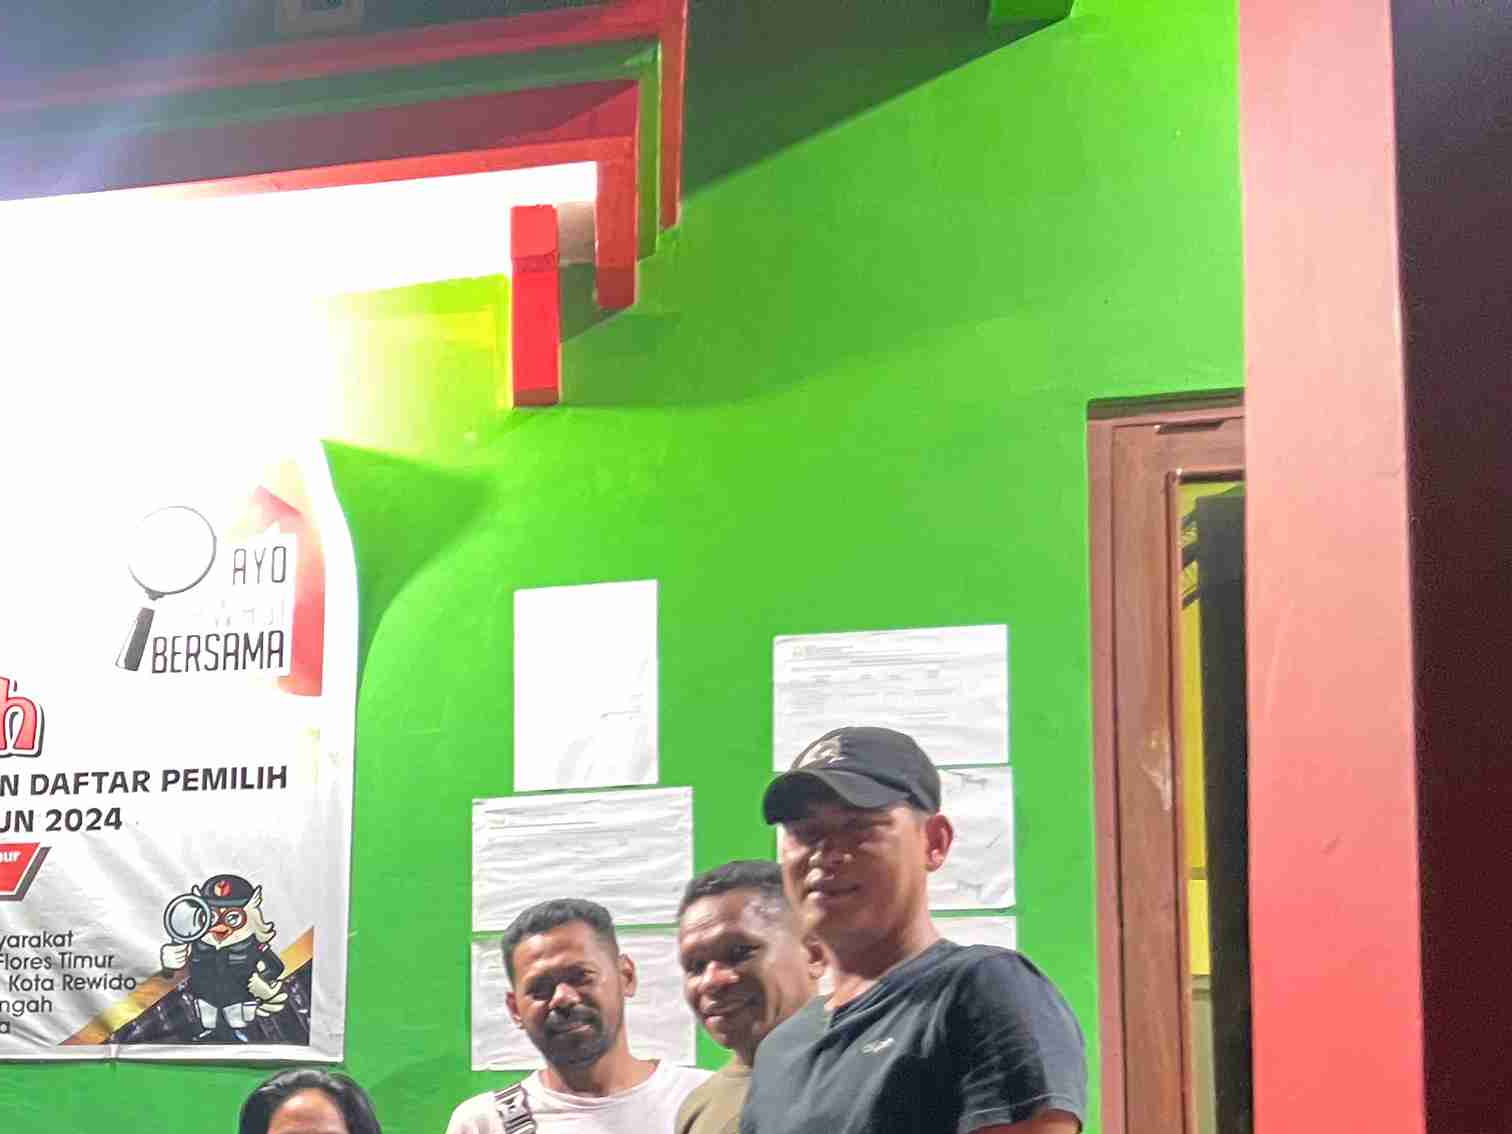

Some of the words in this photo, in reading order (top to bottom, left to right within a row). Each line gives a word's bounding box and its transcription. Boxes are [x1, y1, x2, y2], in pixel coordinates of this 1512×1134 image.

[232, 546, 287, 585] AYO
[152, 630, 284, 673] BERSAMA
[30, 769, 150, 797] DAFTAR
[161, 765, 287, 792] PEMILIH
[46, 807, 123, 832] 2024
[58, 951, 115, 969] Timur
[9, 974, 54, 992] Kota
[62, 973, 137, 991] Rewido
